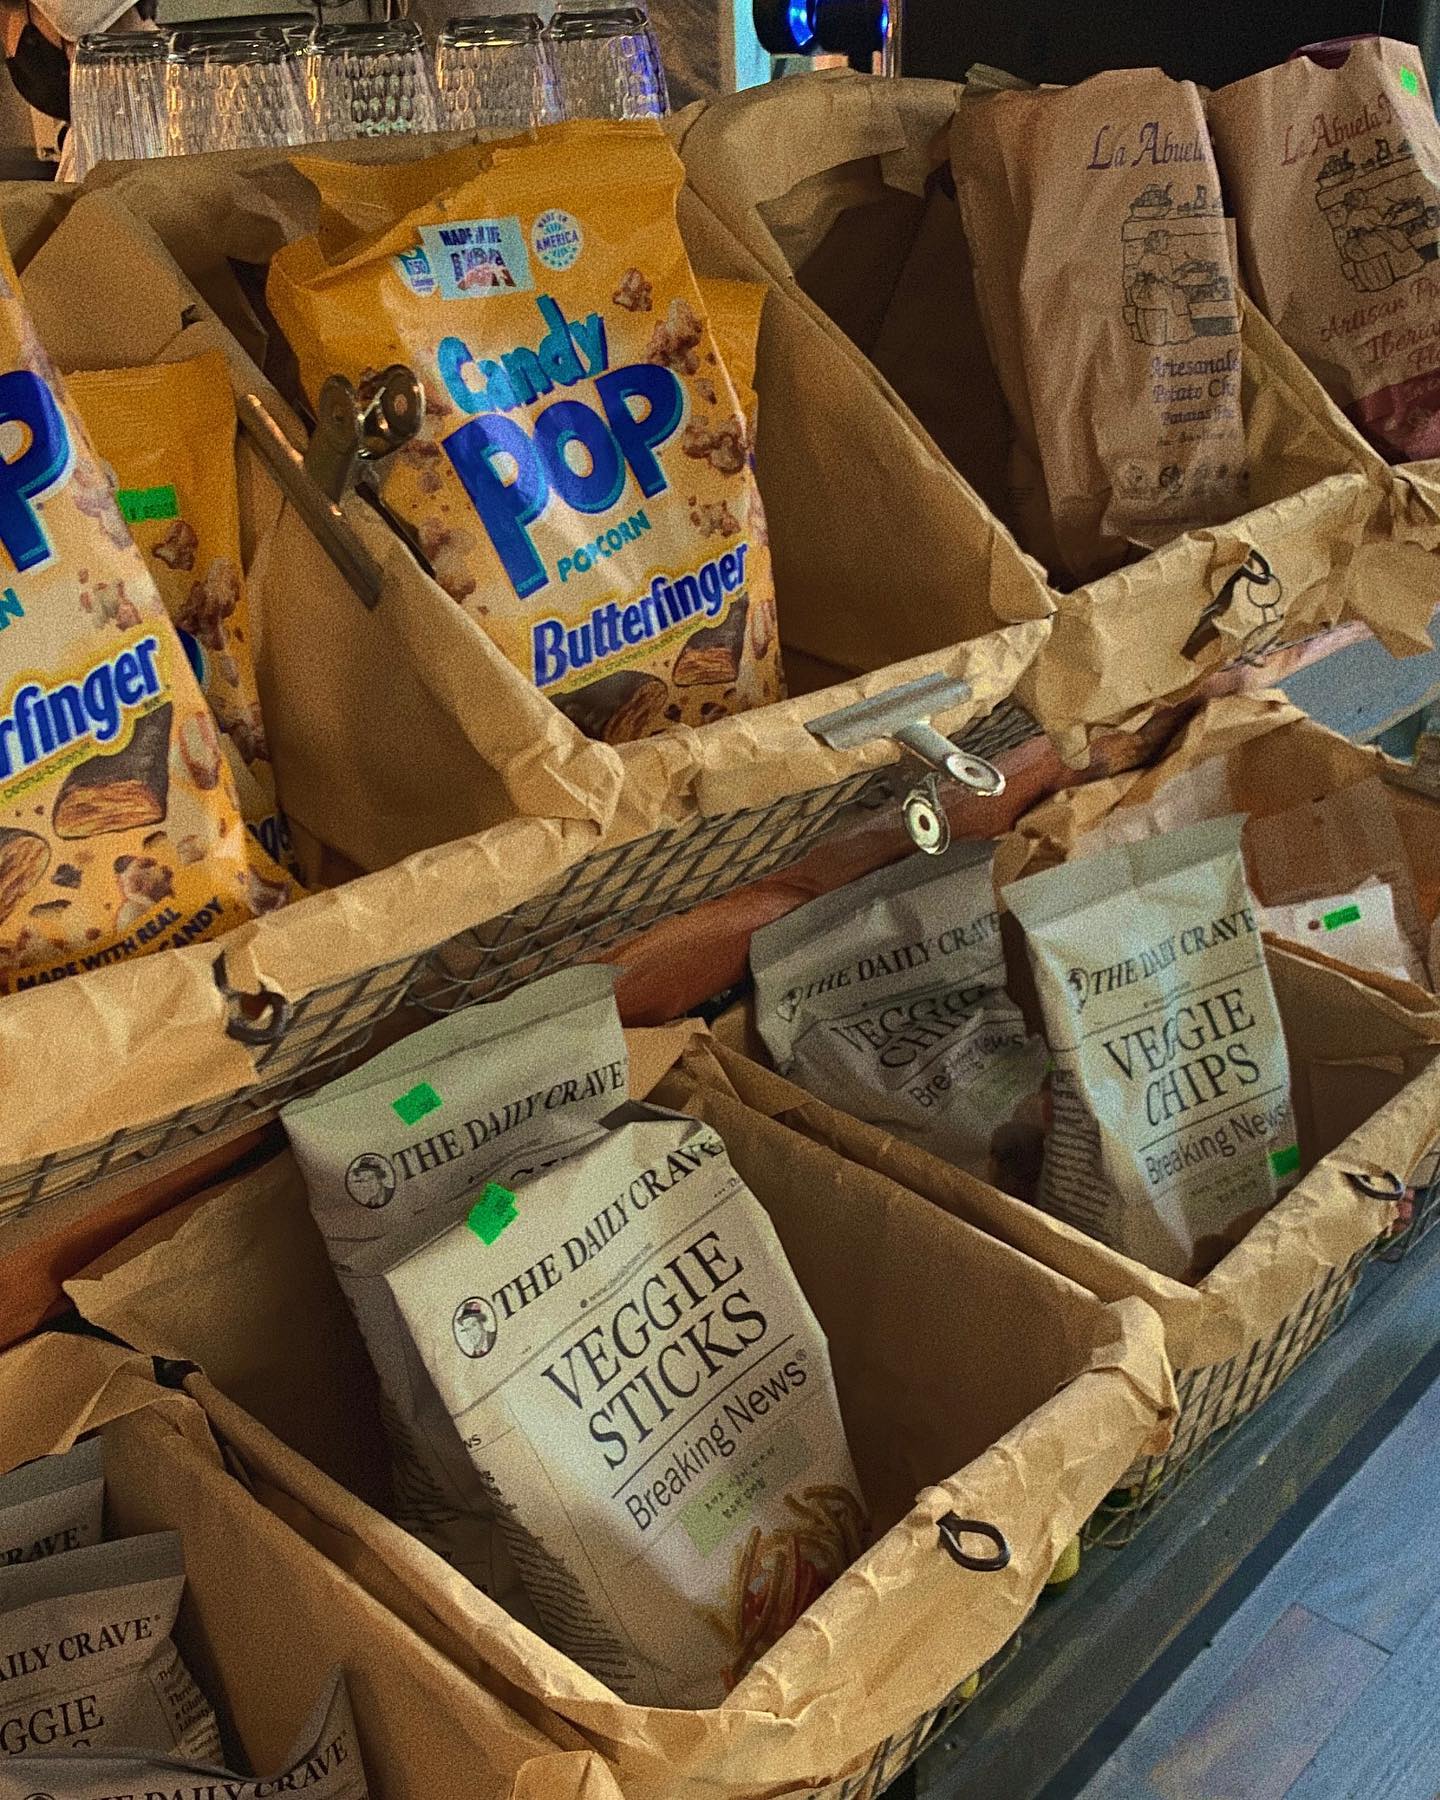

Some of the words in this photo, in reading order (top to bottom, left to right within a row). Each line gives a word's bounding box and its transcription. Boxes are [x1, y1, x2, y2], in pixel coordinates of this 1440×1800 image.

[1087, 124, 1126, 171] La
[1312, 104, 1382, 156] Abuela
[536, 229, 579, 252] AMERICA
[437, 294, 608, 415] Candy
[441, 364, 684, 599] POP
[556, 509, 652, 583] POPCORN
[533, 543, 748, 688] Butterfinger
[16, 961, 80, 992] MADE
[79, 936, 138, 972] WITH
[136, 907, 182, 945] REAL
[806, 966, 852, 1000] THE
[856, 938, 933, 982] DAILY
[938, 910, 1000, 955] CRAVE
[1091, 957, 1139, 996] THE
[1180, 907, 1258, 956] CRAVE
[1103, 988, 1256, 1081] VEGGIE
[391, 1129, 465, 1181] THE
[464, 1090, 542, 1151] DAILY
[543, 1060, 625, 1110] CRAVE
[1146, 1043, 1260, 1126] CHIPS
[1145, 1125, 1237, 1185] Breaking
[491, 1253, 563, 1320] THE
[561, 1193, 629, 1272] DAILY
[629, 1134, 724, 1210] CRAVE
[540, 1230, 744, 1410] VEGGIE
[588, 1288, 767, 1470] STICKS
[625, 1418, 736, 1531] Breaking
[0, 1528, 80, 1563] RAVE
[59, 1617, 152, 1661] CRAVE
[0, 1694, 104, 1755] GGIE
